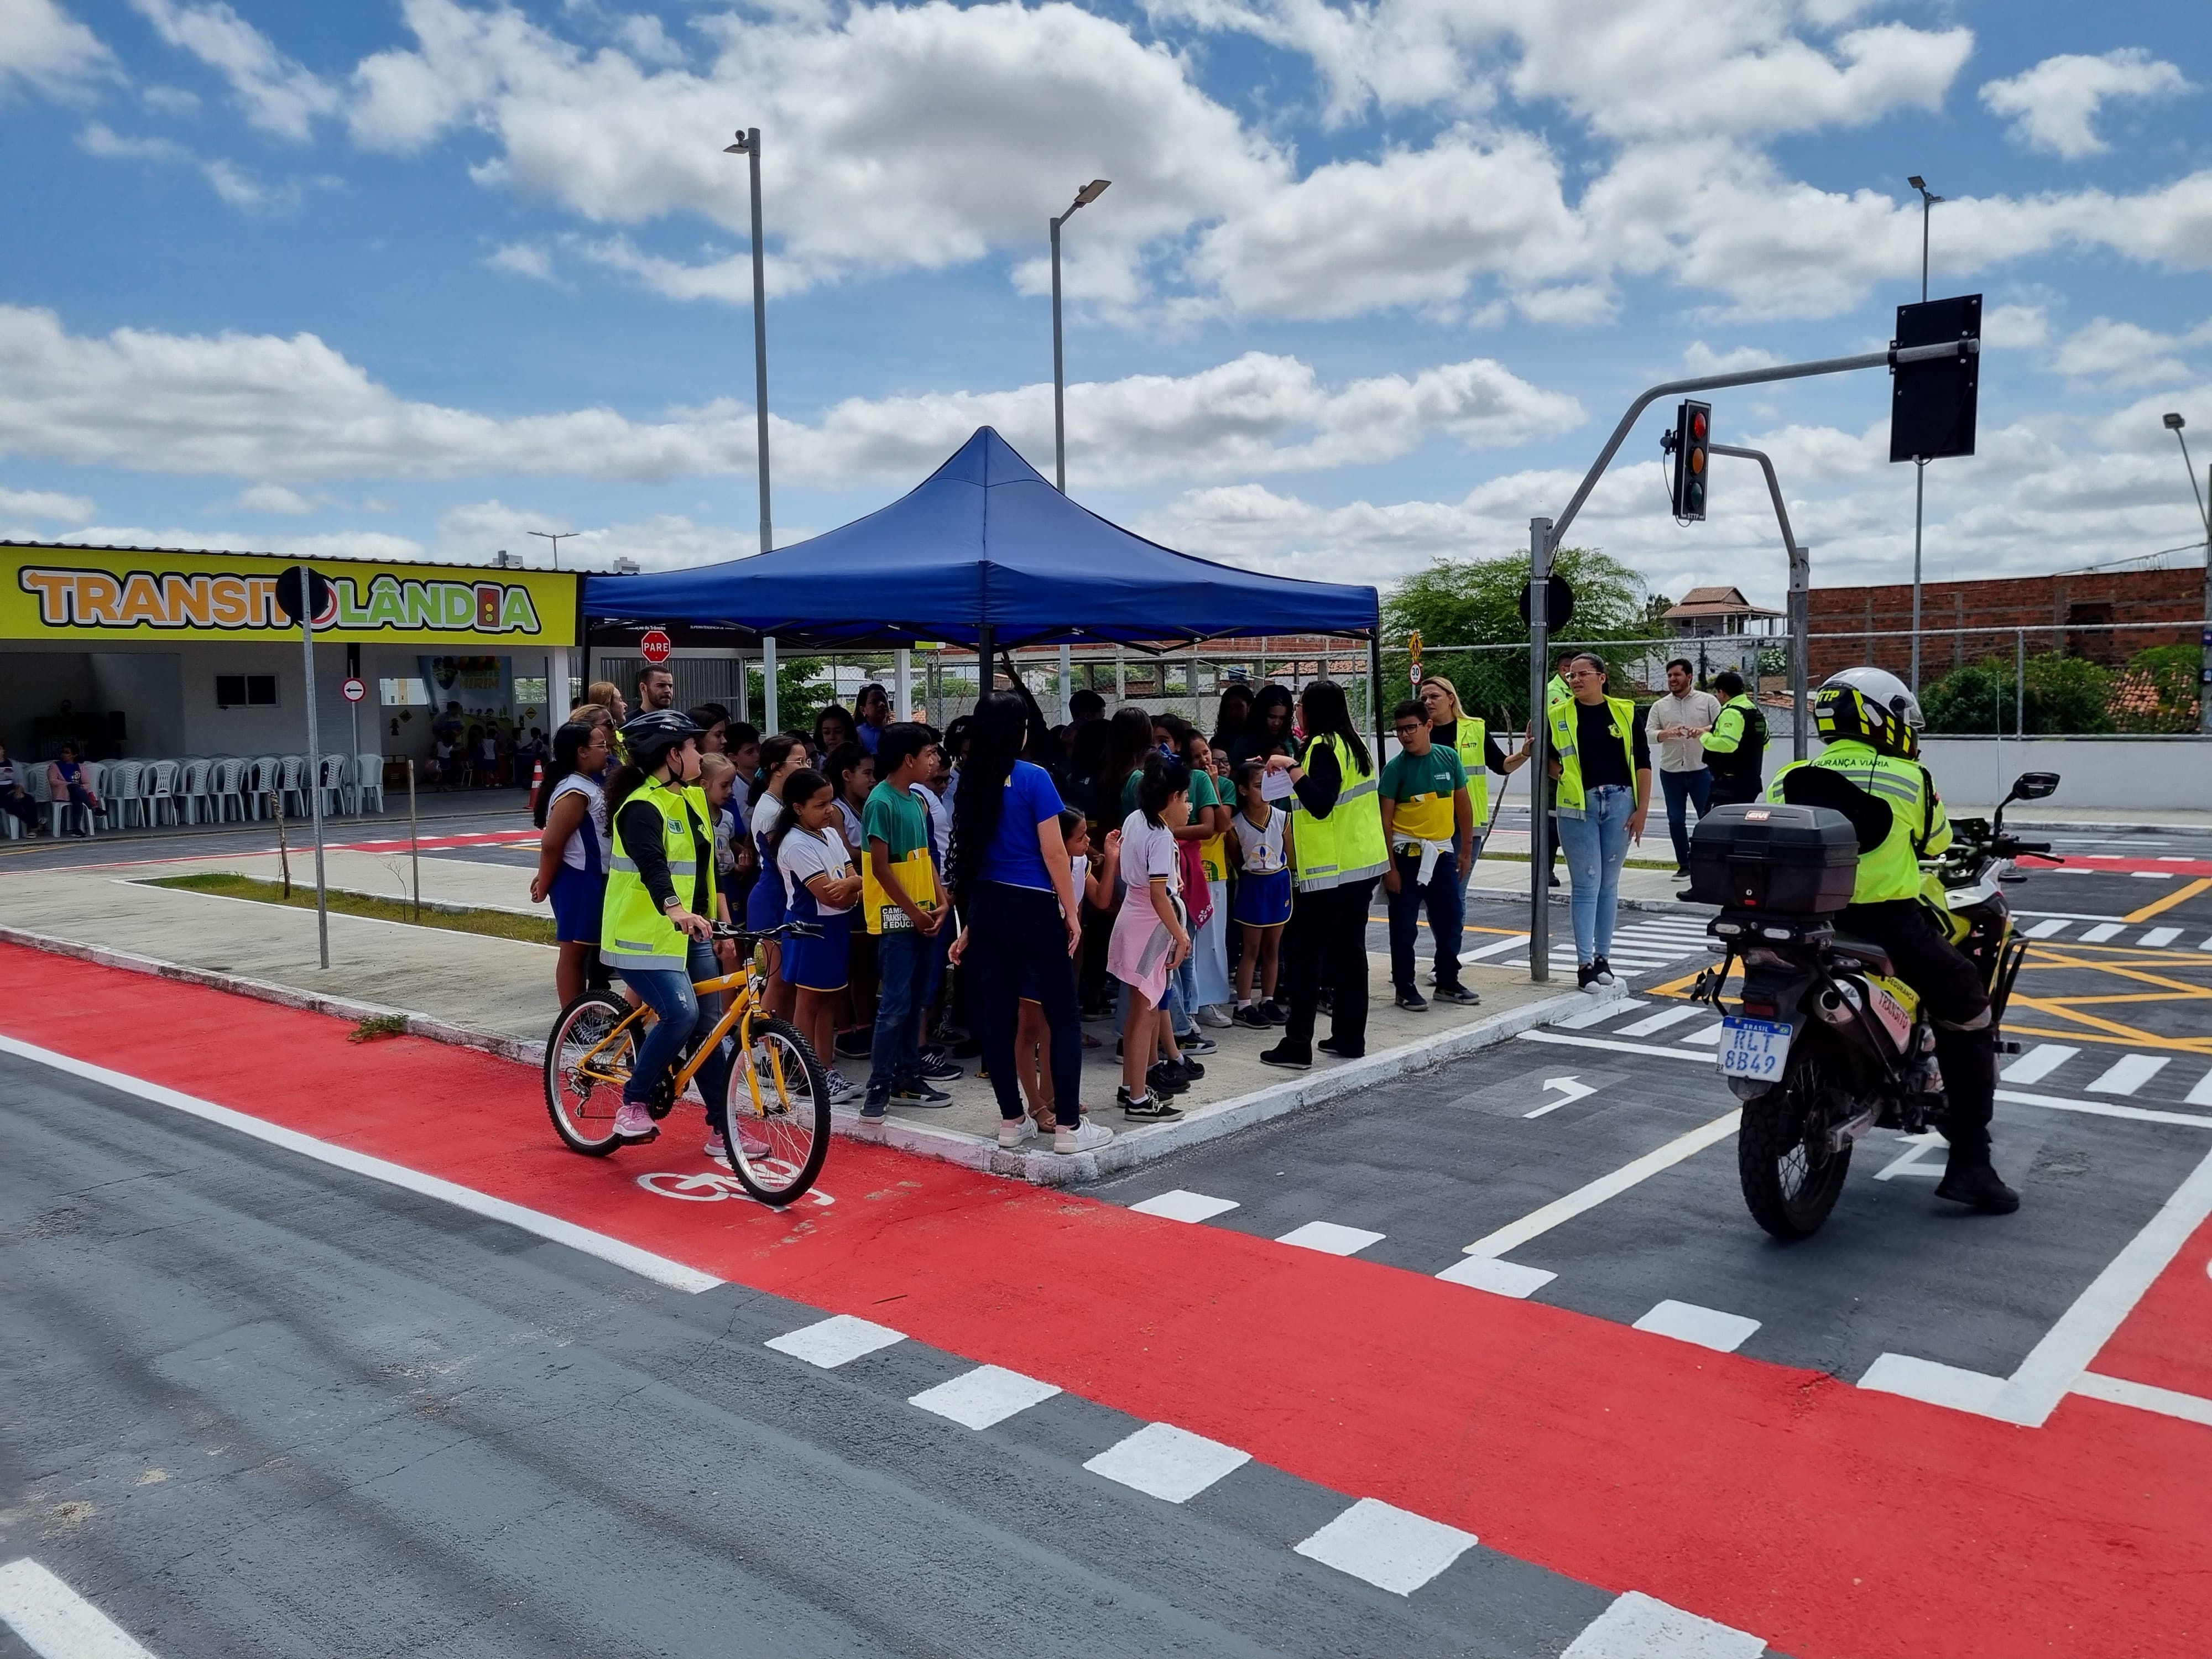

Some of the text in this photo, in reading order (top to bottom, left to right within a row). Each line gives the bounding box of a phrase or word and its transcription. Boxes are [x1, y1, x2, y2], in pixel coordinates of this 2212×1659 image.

[644, 643, 669, 652] PARE
[1412, 667, 1420, 676] 30
[1879, 990, 1908, 1029] TRANSITO
[1743, 1023, 1769, 1032] BRASIL
[1734, 1030, 1774, 1052] RLT
[1725, 1050, 1776, 1074] 8B49
